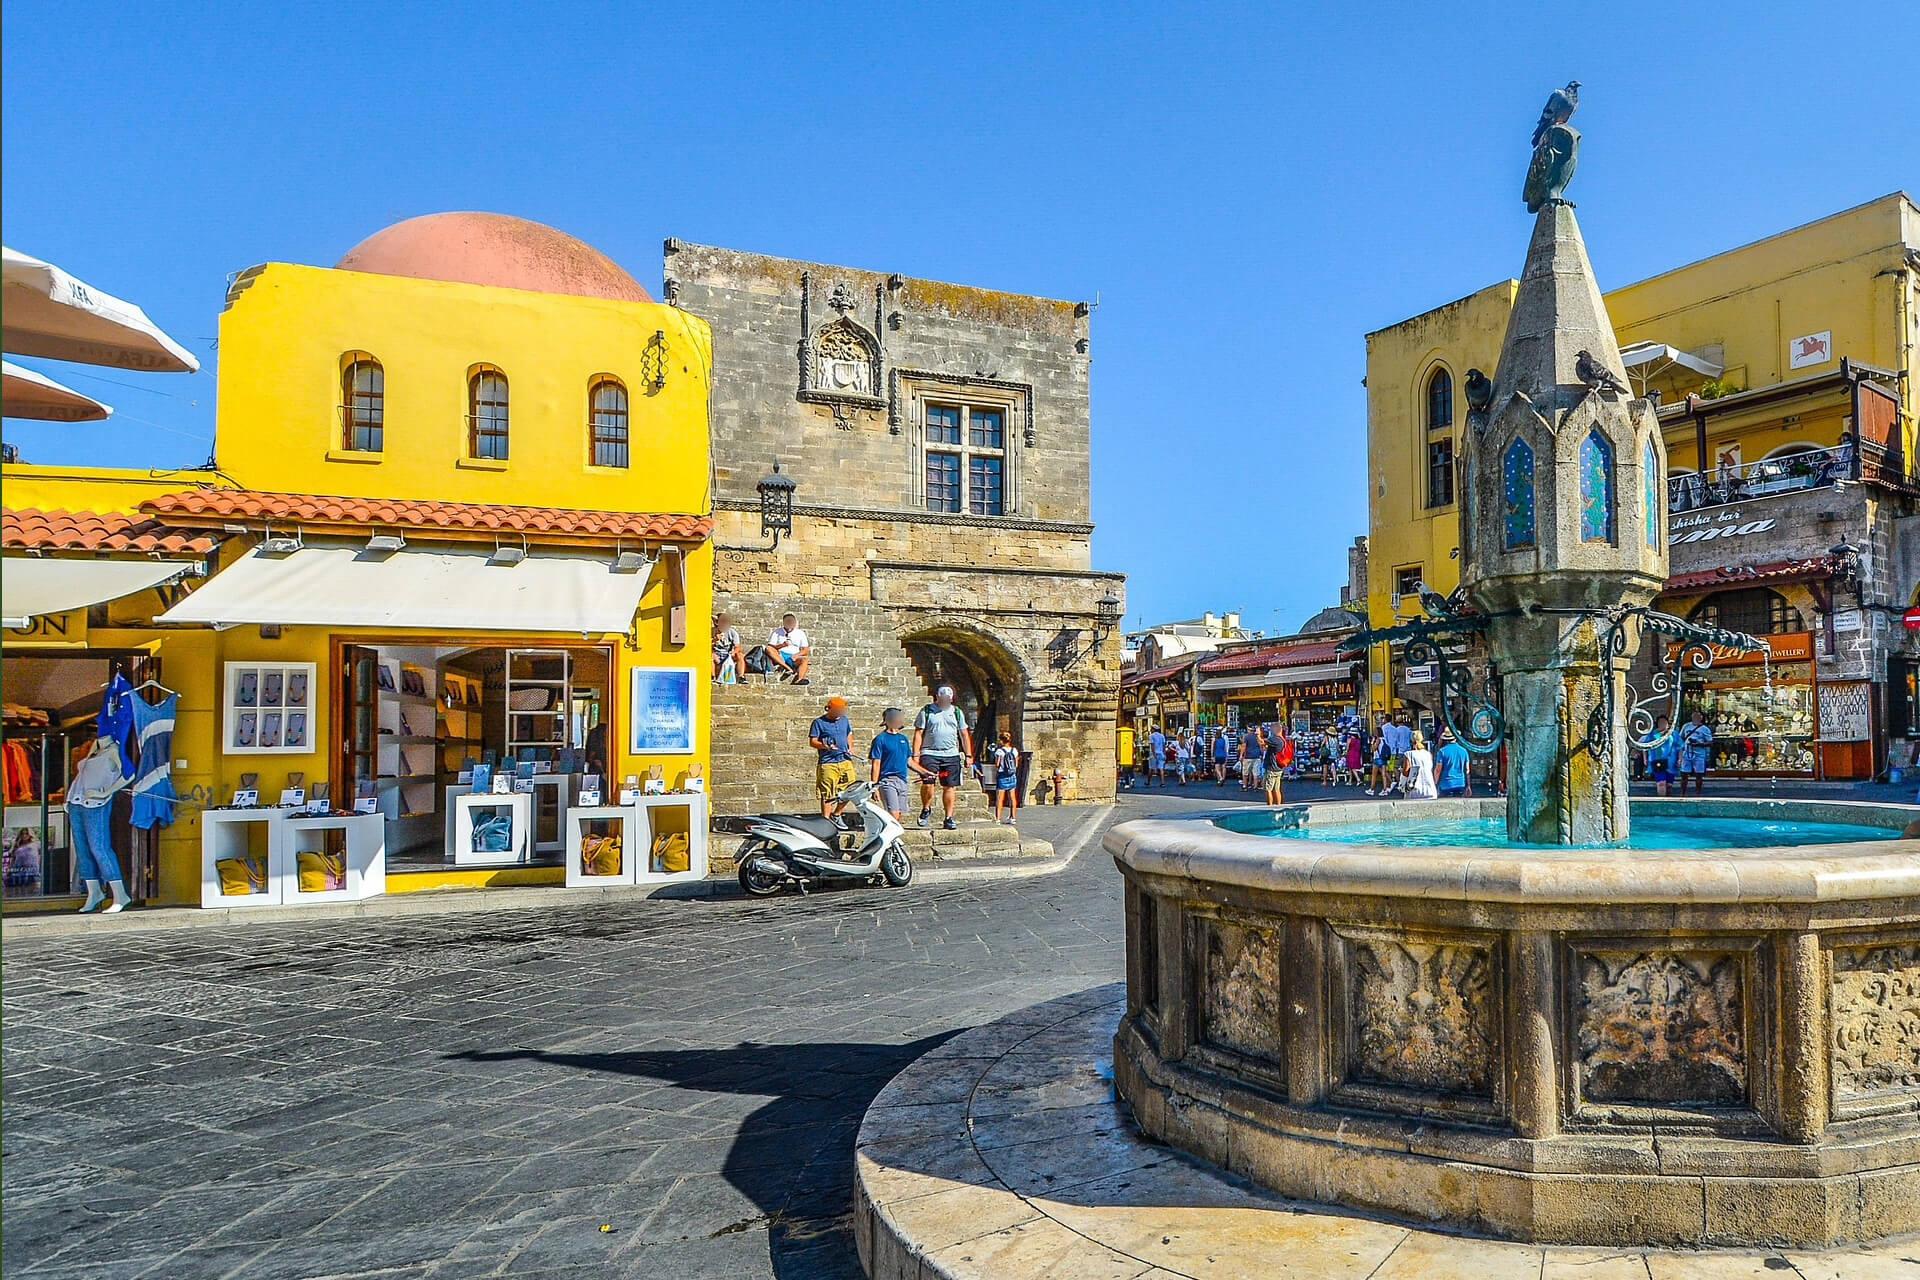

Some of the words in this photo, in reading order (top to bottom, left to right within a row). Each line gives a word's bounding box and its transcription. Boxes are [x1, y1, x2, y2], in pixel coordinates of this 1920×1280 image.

[1670, 514, 1712, 530] shisha
[1718, 509, 1742, 522] bar
[1289, 687, 1301, 697] LA
[1304, 683, 1352, 696] FONTANA
